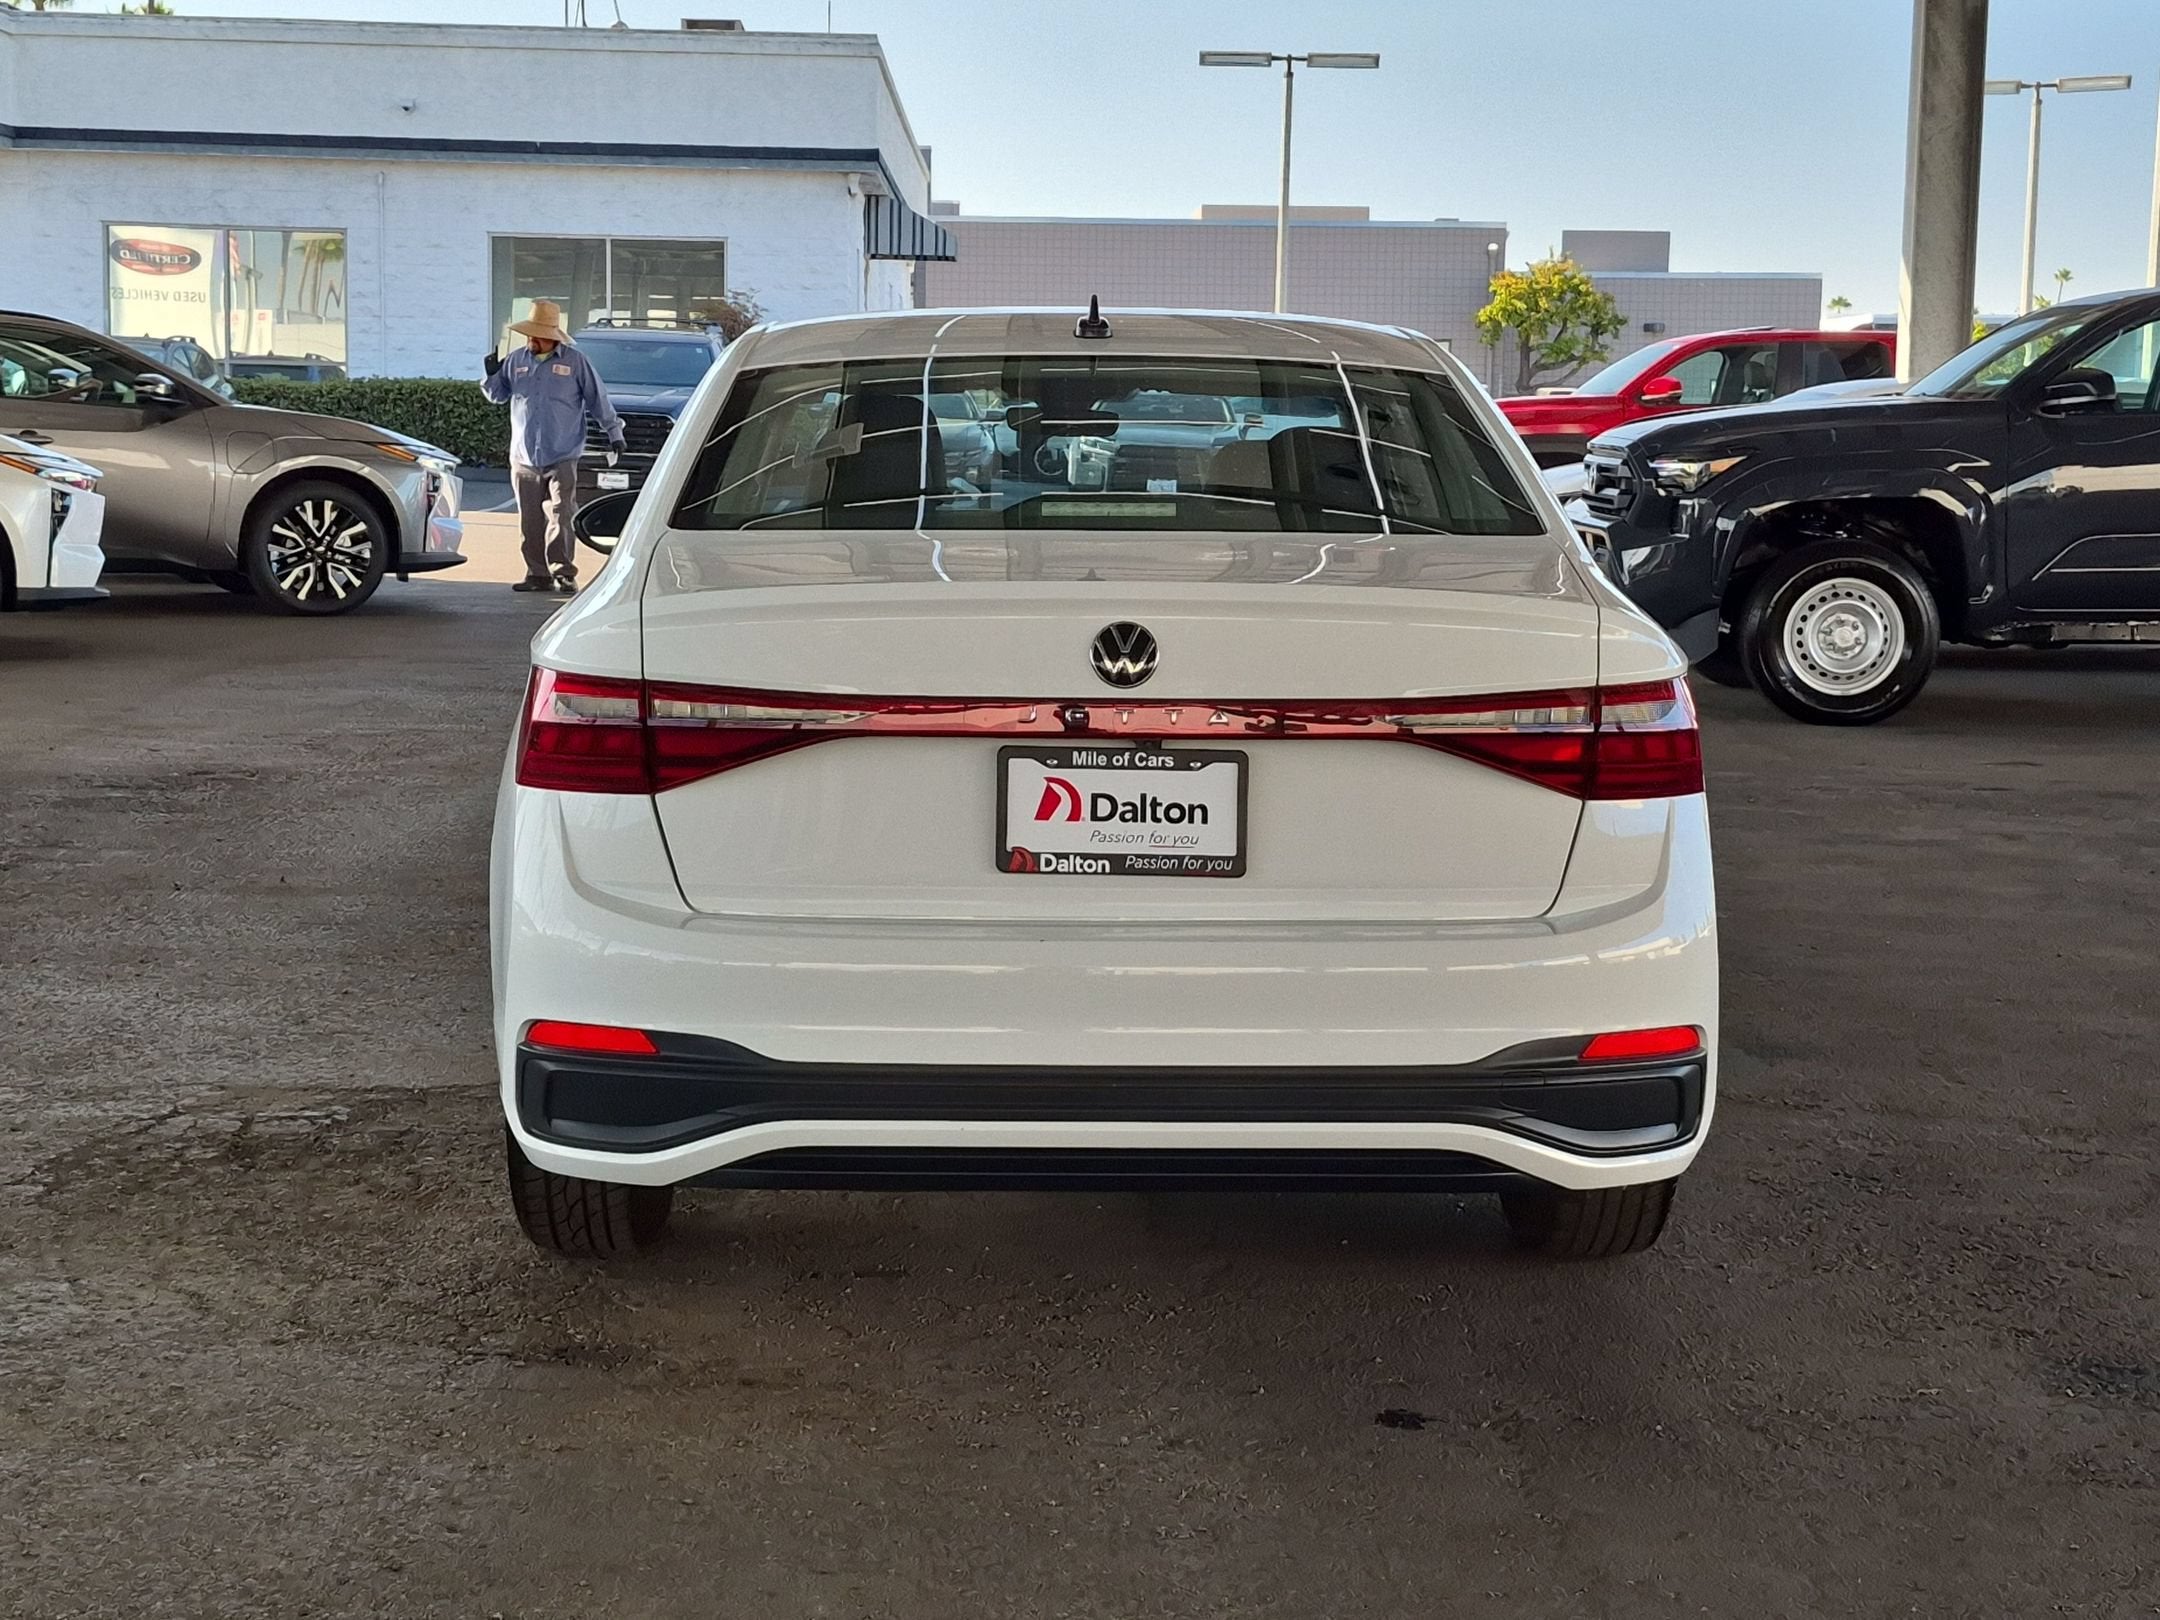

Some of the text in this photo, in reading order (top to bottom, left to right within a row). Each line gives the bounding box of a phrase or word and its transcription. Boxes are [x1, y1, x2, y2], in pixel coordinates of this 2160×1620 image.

[1072, 751, 1175, 767] Mile of Cars
[1090, 793, 1208, 825] Dalton
[1090, 830, 1199, 846] Passion for you
[1040, 854, 1233, 873] Dalton Passion for you
